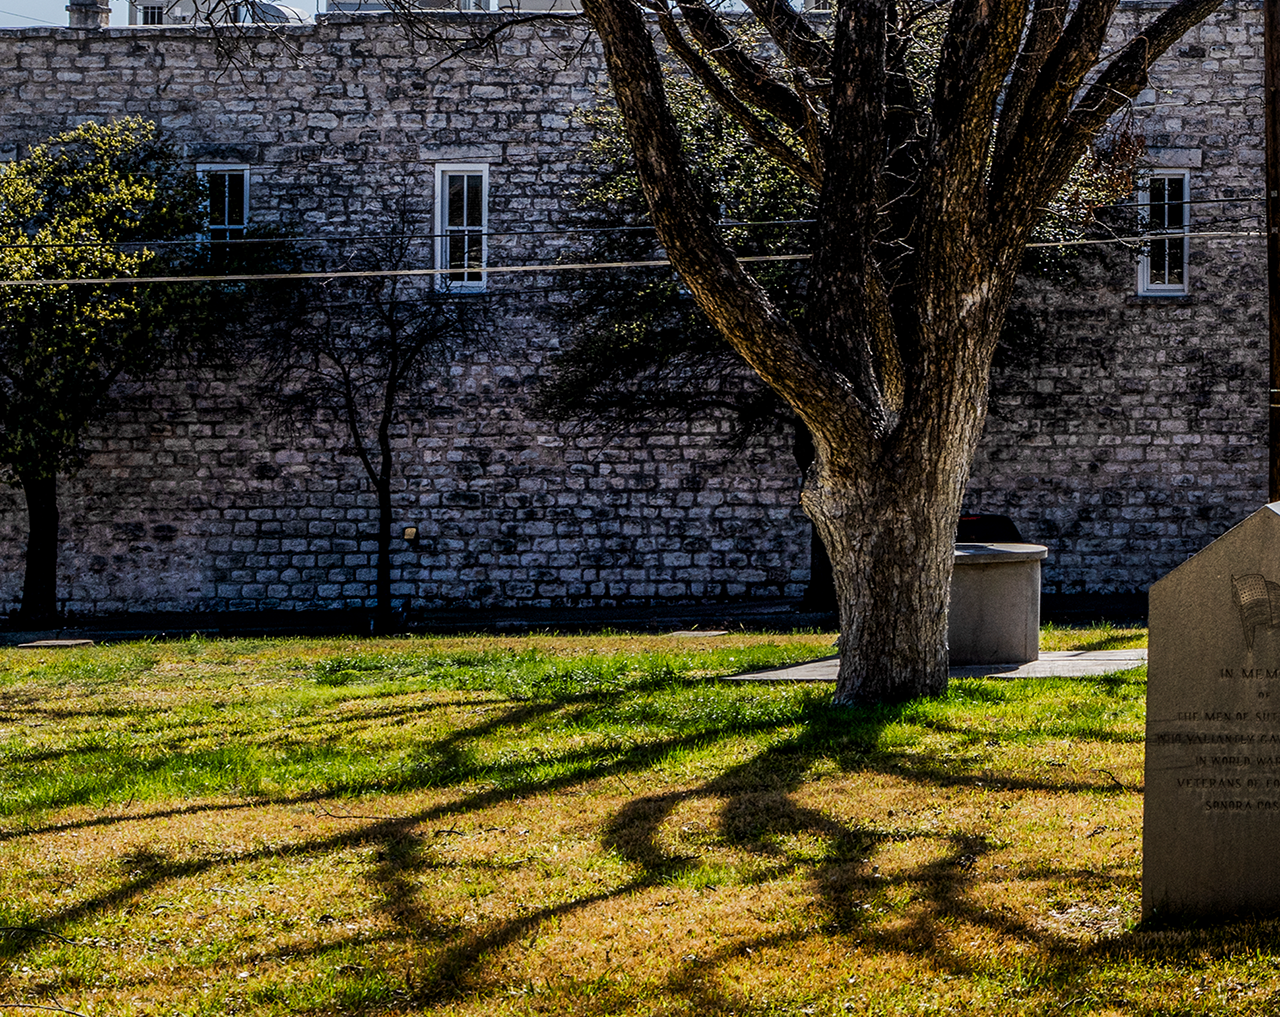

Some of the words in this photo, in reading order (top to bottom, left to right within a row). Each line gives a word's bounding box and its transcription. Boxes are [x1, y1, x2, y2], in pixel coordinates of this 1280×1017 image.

[1220, 668, 1234, 680] IN
[1257, 691, 1271, 700] OF
[1176, 711, 1199, 723] THE
[1204, 711, 1232, 723] MEN
[1235, 711, 1249, 723] OF
[1156, 734, 1183, 745] WHO
[1186, 734, 1255, 745] VALIANTLY
[1195, 756, 1207, 767] IN
[1210, 756, 1251, 767] WORLD
[1176, 778, 1242, 790] VETERANS
[1246, 778, 1259, 790] OF
[1204, 800, 1252, 812] SONORA
